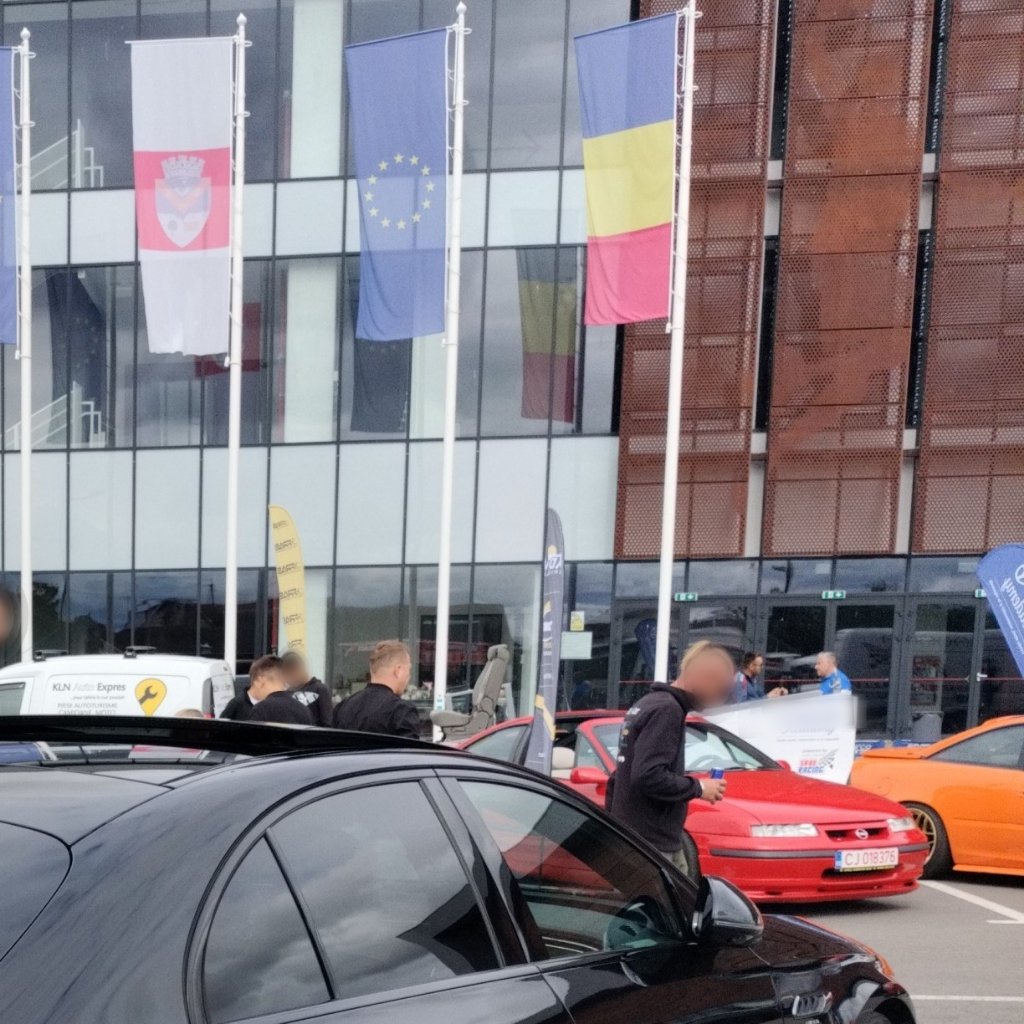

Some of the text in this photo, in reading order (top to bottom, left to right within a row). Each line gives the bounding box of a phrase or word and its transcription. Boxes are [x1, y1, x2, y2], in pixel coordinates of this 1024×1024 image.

[52, 683, 71, 692] KLN
[97, 683, 126, 694] Expres
[845, 853, 860, 866] CJ
